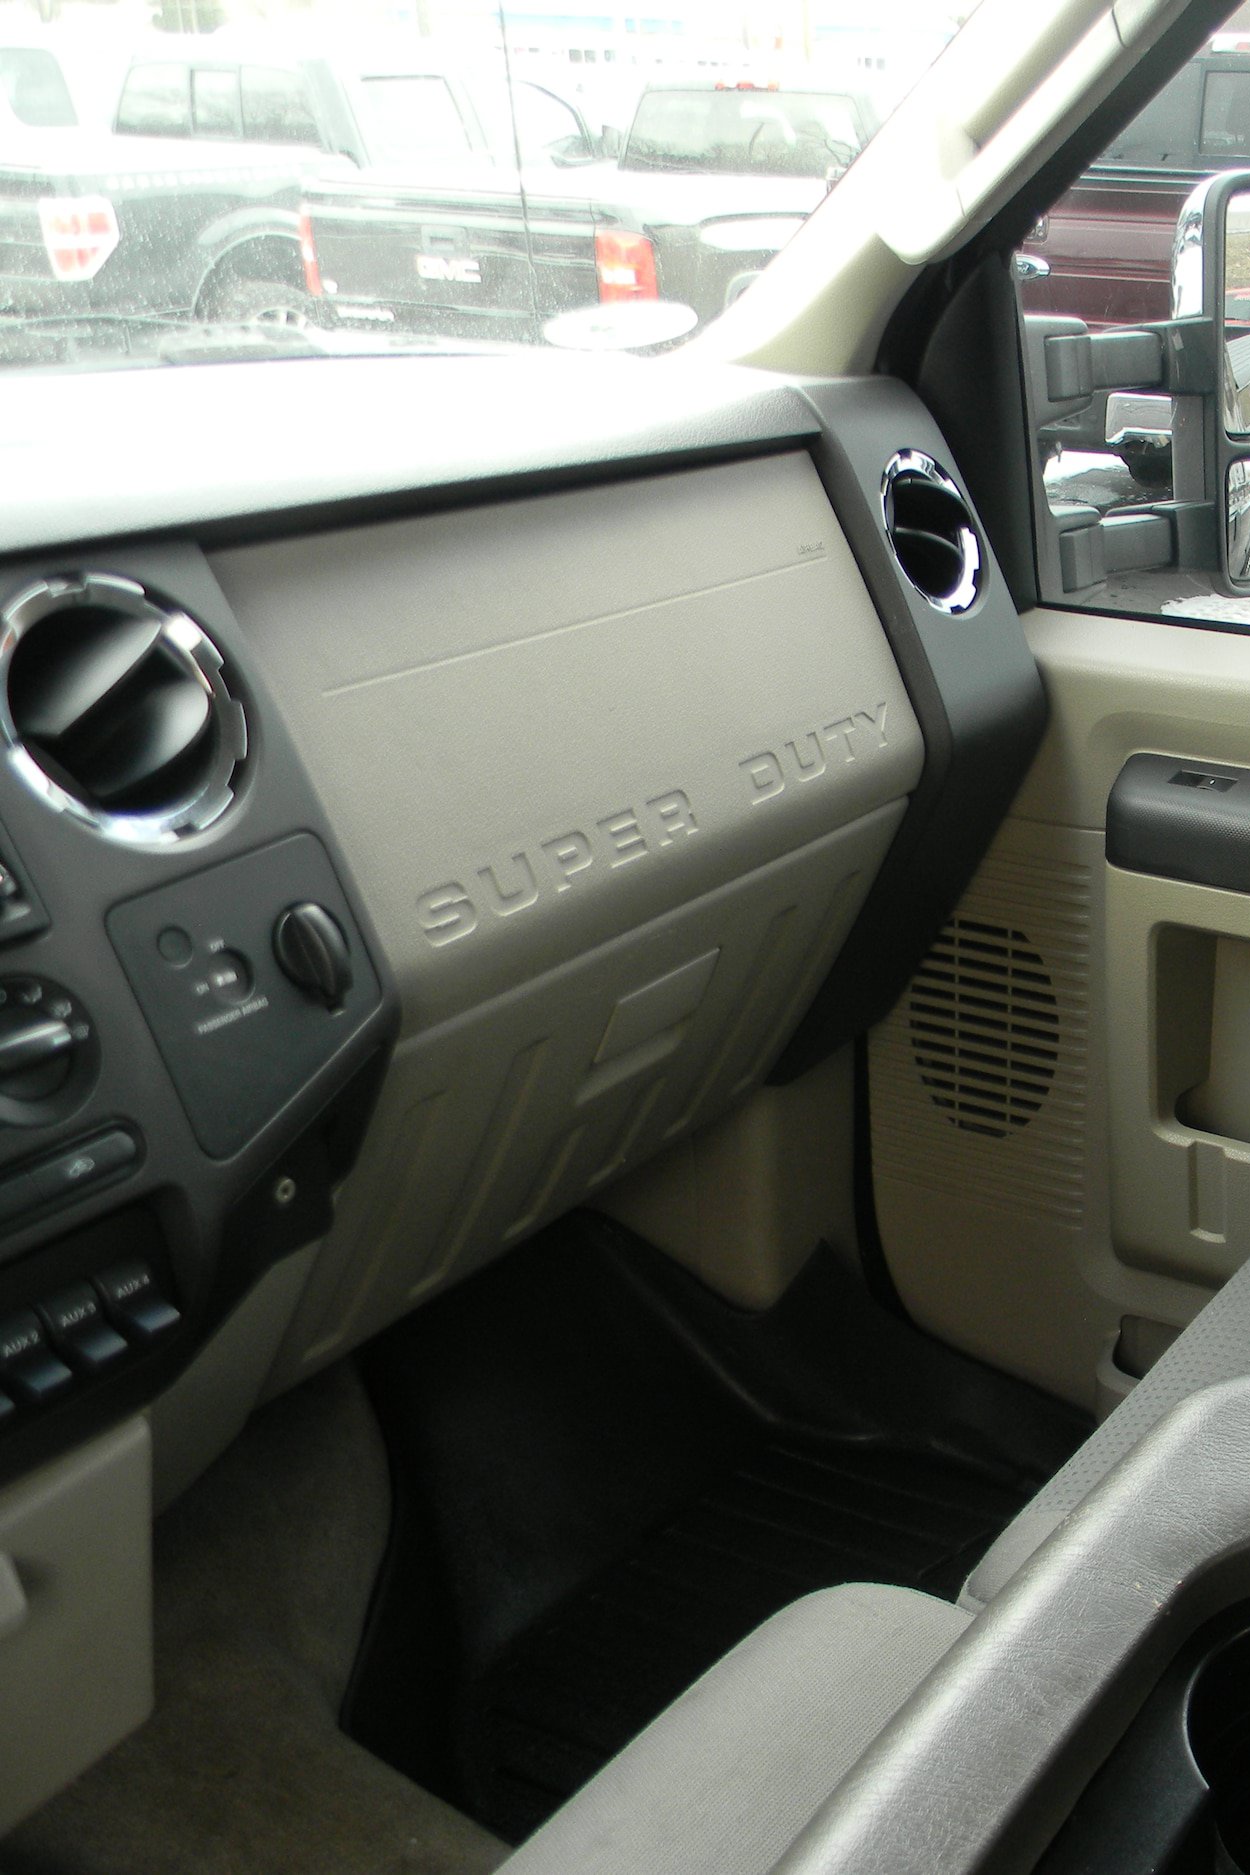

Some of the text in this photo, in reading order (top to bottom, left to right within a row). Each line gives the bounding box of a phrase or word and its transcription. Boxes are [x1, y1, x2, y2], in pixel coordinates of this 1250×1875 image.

[417, 255, 481, 283] GMC
[415, 702, 888, 948] SUPER DUTY
[115, 1280, 141, 1299] AUX
[61, 1308, 87, 1327] AUX
[3, 1335, 32, 1358] AUX
